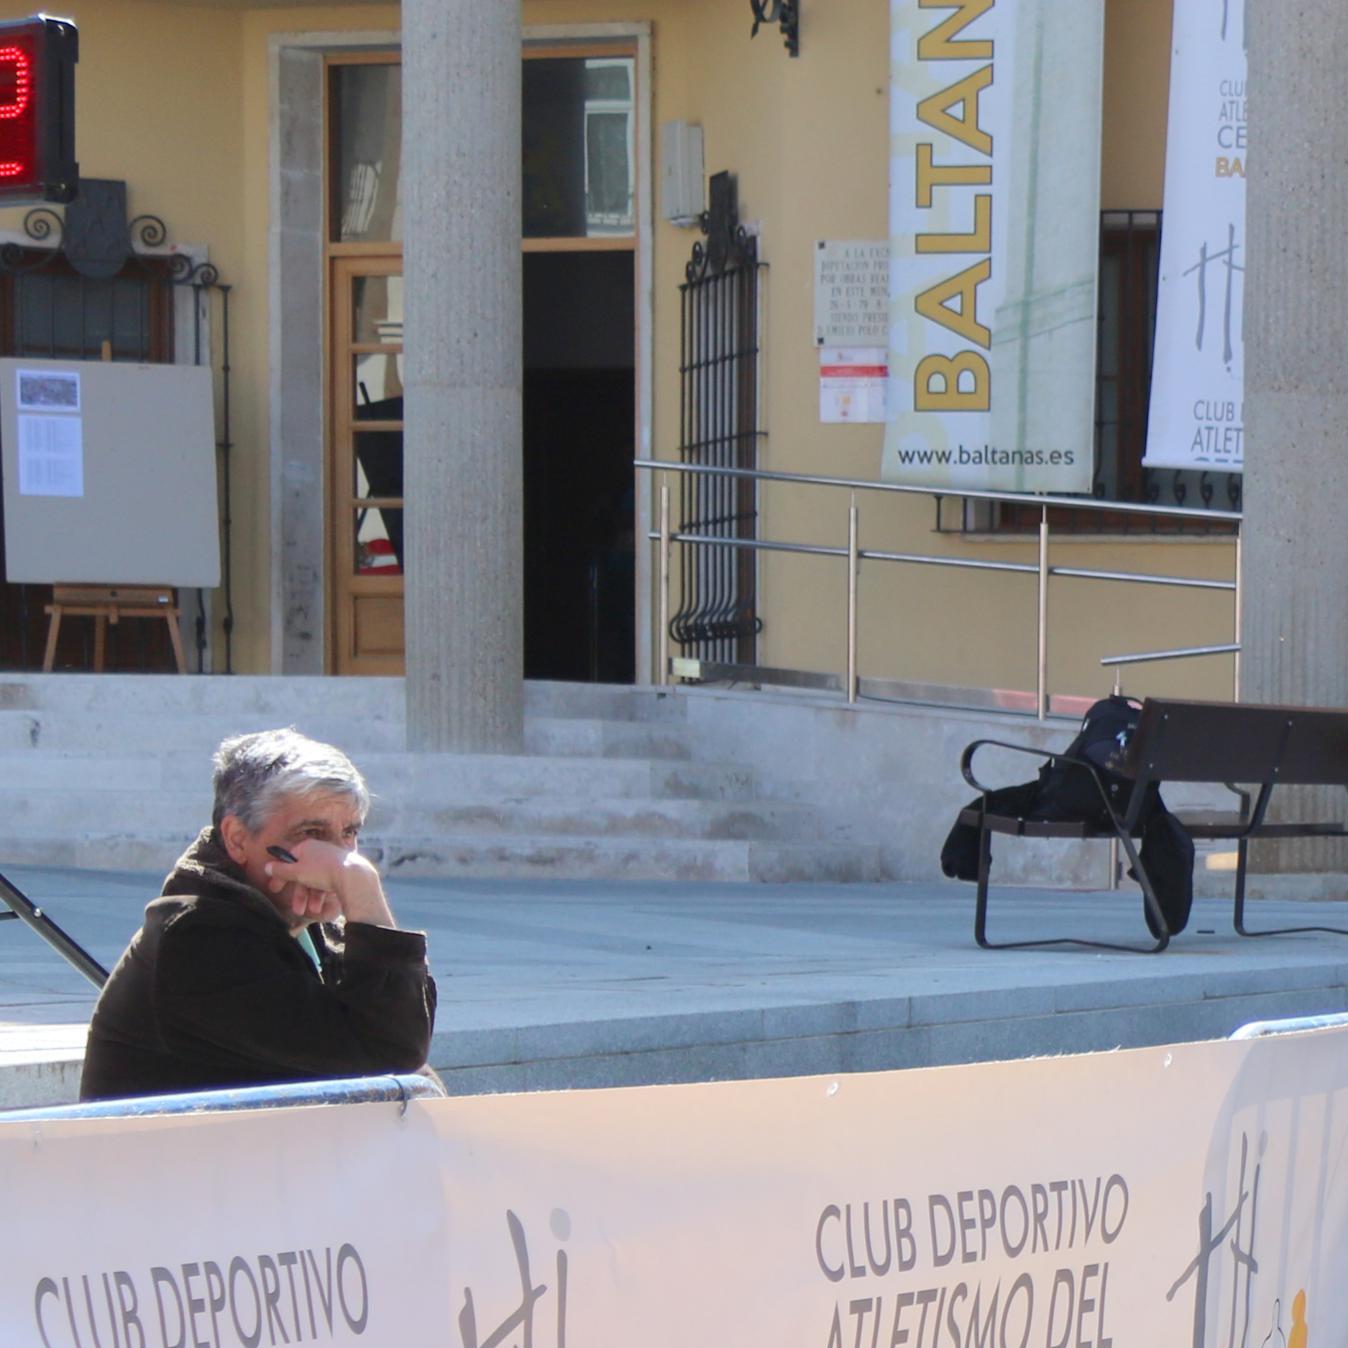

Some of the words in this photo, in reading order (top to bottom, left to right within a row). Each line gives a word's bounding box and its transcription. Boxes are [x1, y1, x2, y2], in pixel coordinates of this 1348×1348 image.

[1219, 79, 1247, 97] CLU
[1193, 399, 1234, 422] CLUB
[898, 445, 1074, 467] www.baltanas.es
[816, 1197, 917, 1283] CLUB
[928, 1173, 1128, 1268] DEPORTIVO
